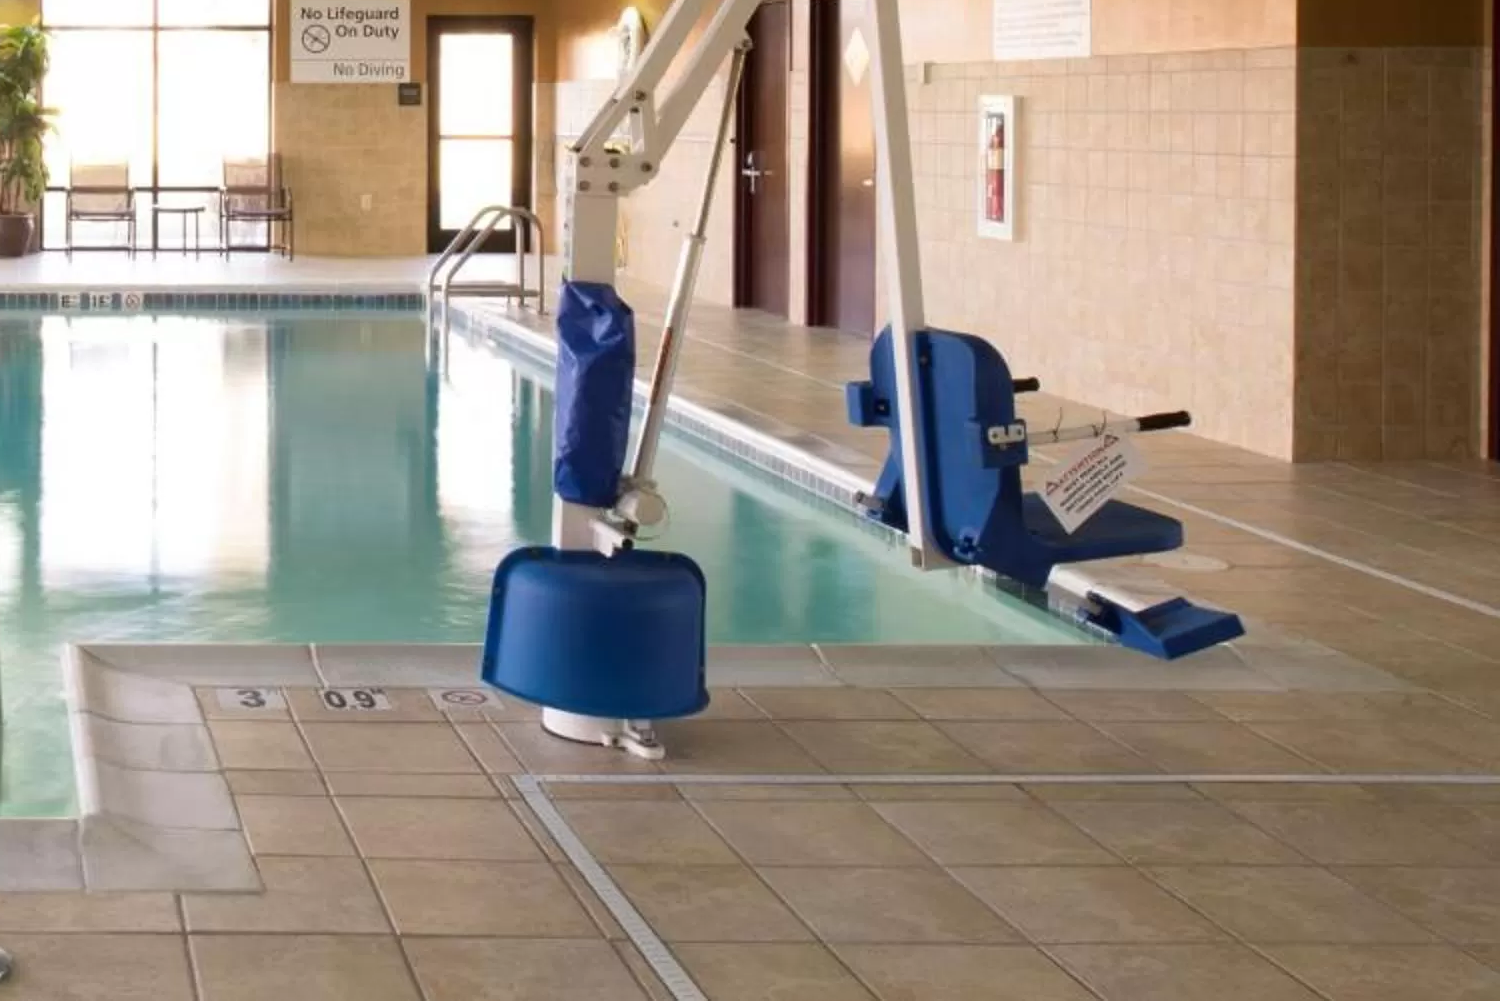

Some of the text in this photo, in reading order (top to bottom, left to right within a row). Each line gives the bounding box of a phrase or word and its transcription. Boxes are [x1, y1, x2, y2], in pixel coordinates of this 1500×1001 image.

[300, 6, 399, 23] No Lifeguard
[335, 24, 400, 40] On Duty
[333, 62, 405, 79] No Diving
[237, 690, 266, 708] 3
